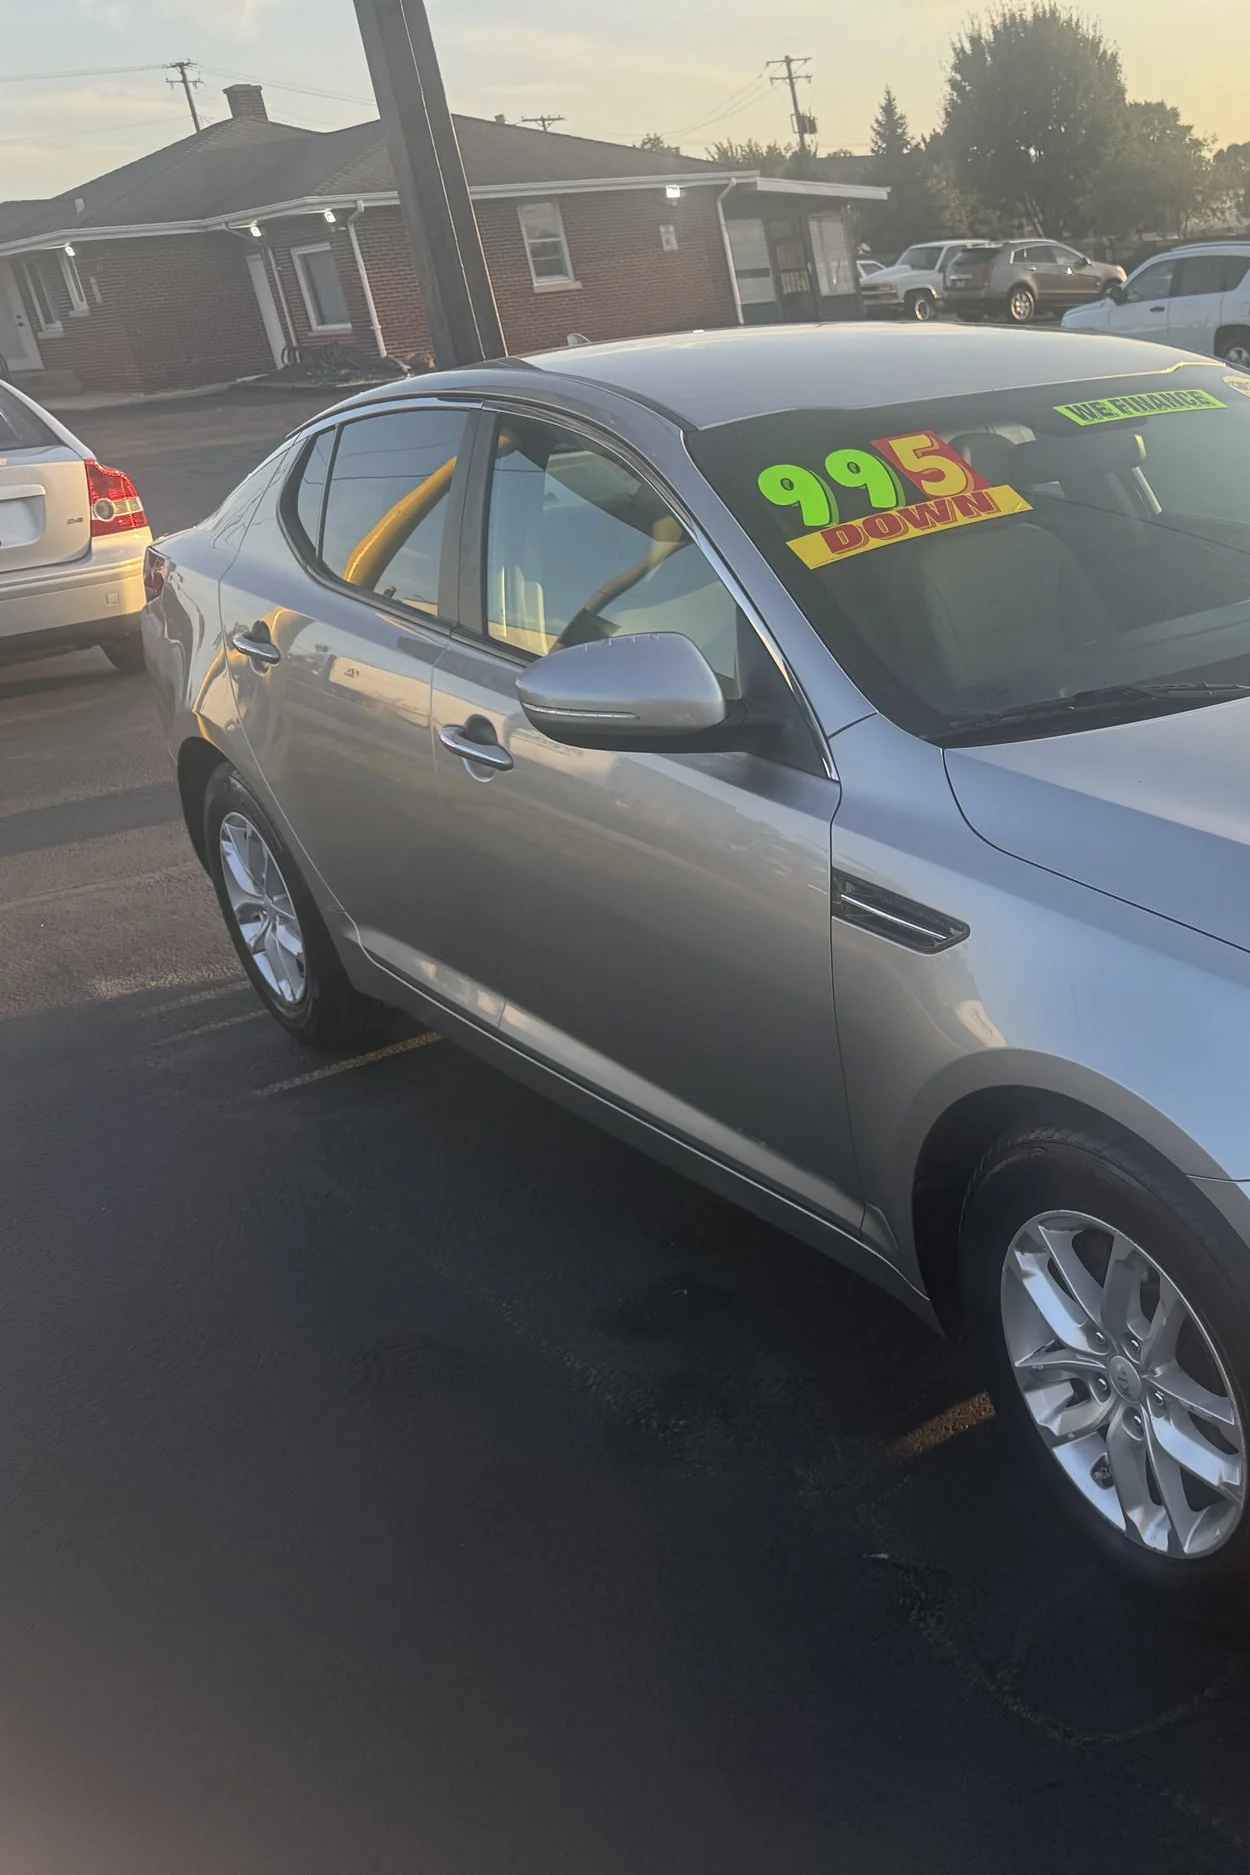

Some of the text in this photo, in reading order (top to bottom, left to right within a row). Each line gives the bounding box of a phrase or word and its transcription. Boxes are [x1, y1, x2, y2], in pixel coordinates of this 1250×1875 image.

[1064, 389, 1212, 423] WE FINANCE
[757, 434, 976, 529] 995
[820, 490, 1003, 556] DOWN
